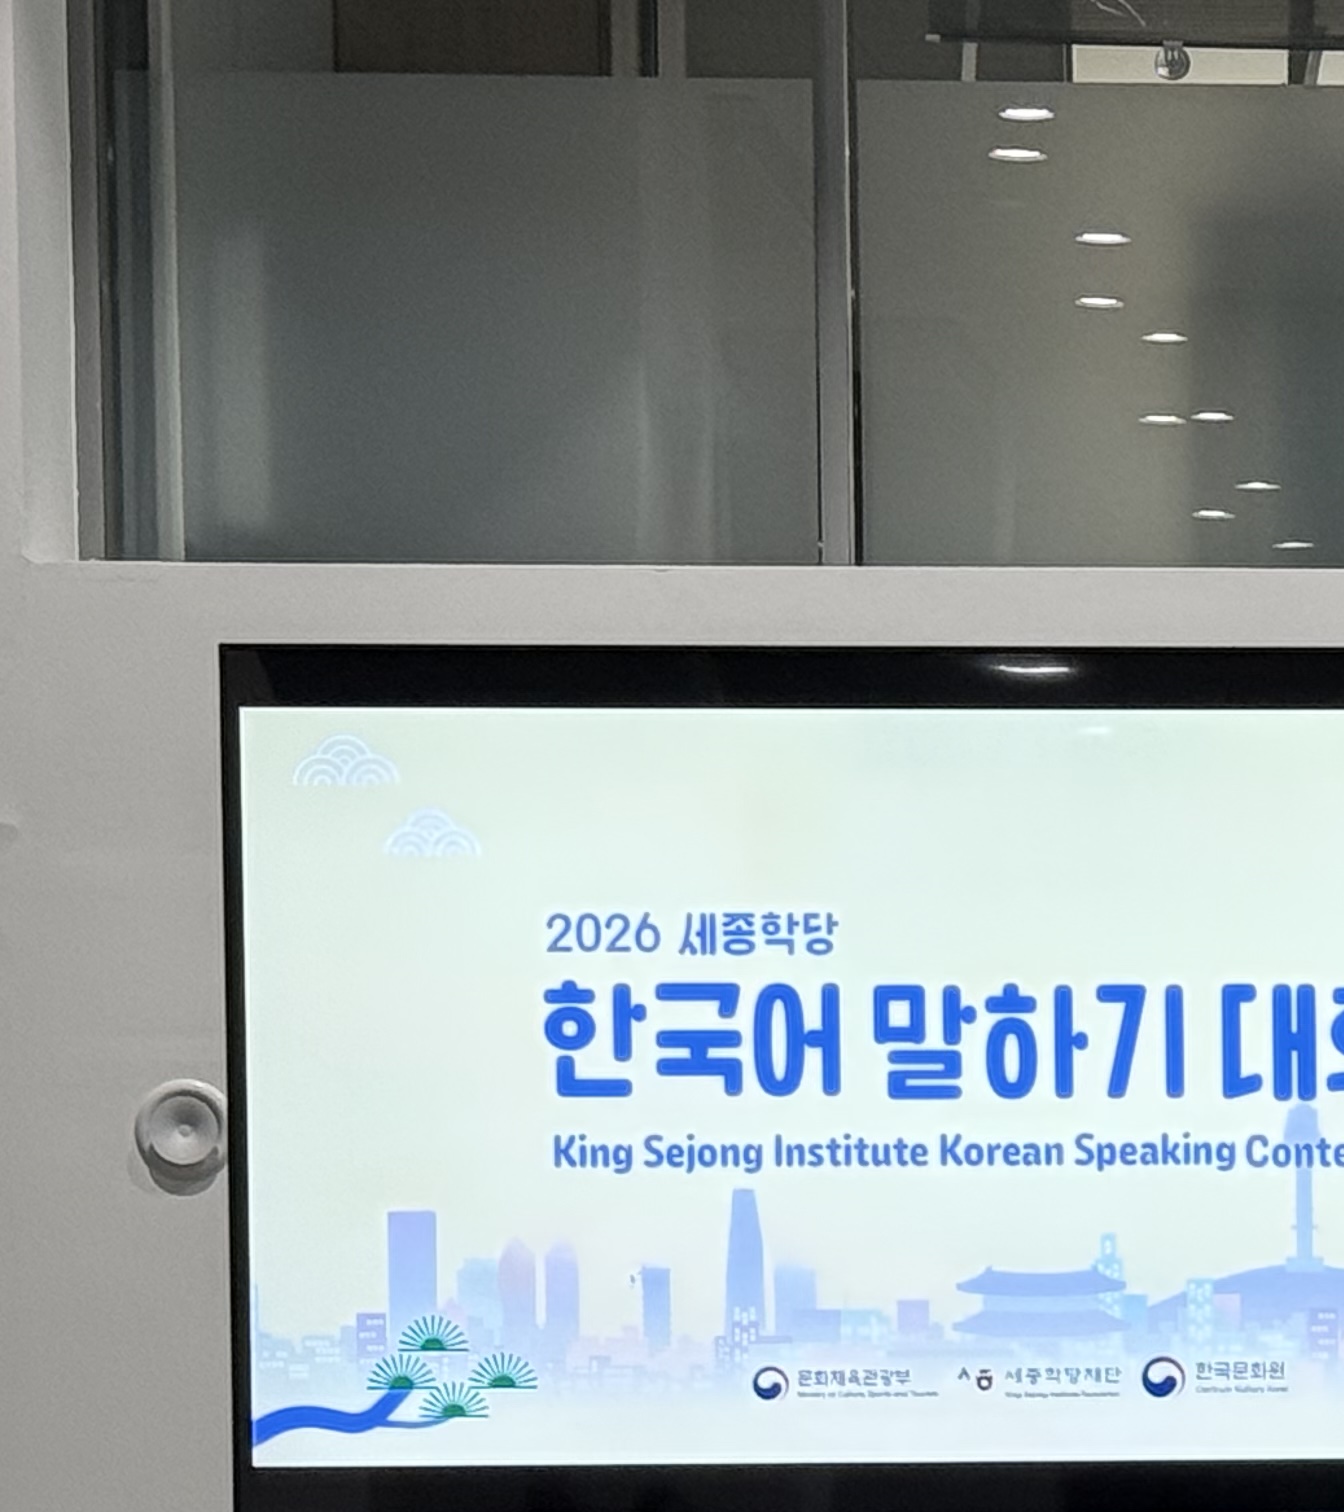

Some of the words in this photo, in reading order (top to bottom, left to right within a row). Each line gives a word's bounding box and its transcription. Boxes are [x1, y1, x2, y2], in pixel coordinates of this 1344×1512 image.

[546, 912, 662, 954] 2026
[678, 911, 840, 957] 세종학당
[543, 979, 842, 1098] 한국어
[872, 982, 1188, 1100] 말하기
[552, 1133, 634, 1175] King
[643, 1133, 763, 1175] Sejong
[774, 1133, 929, 1168] Institute
[939, 1132, 1064, 1168] Korean
[1074, 1131, 1236, 1172] Speaking
[1195, 1361, 1286, 1381] 한국문화원
